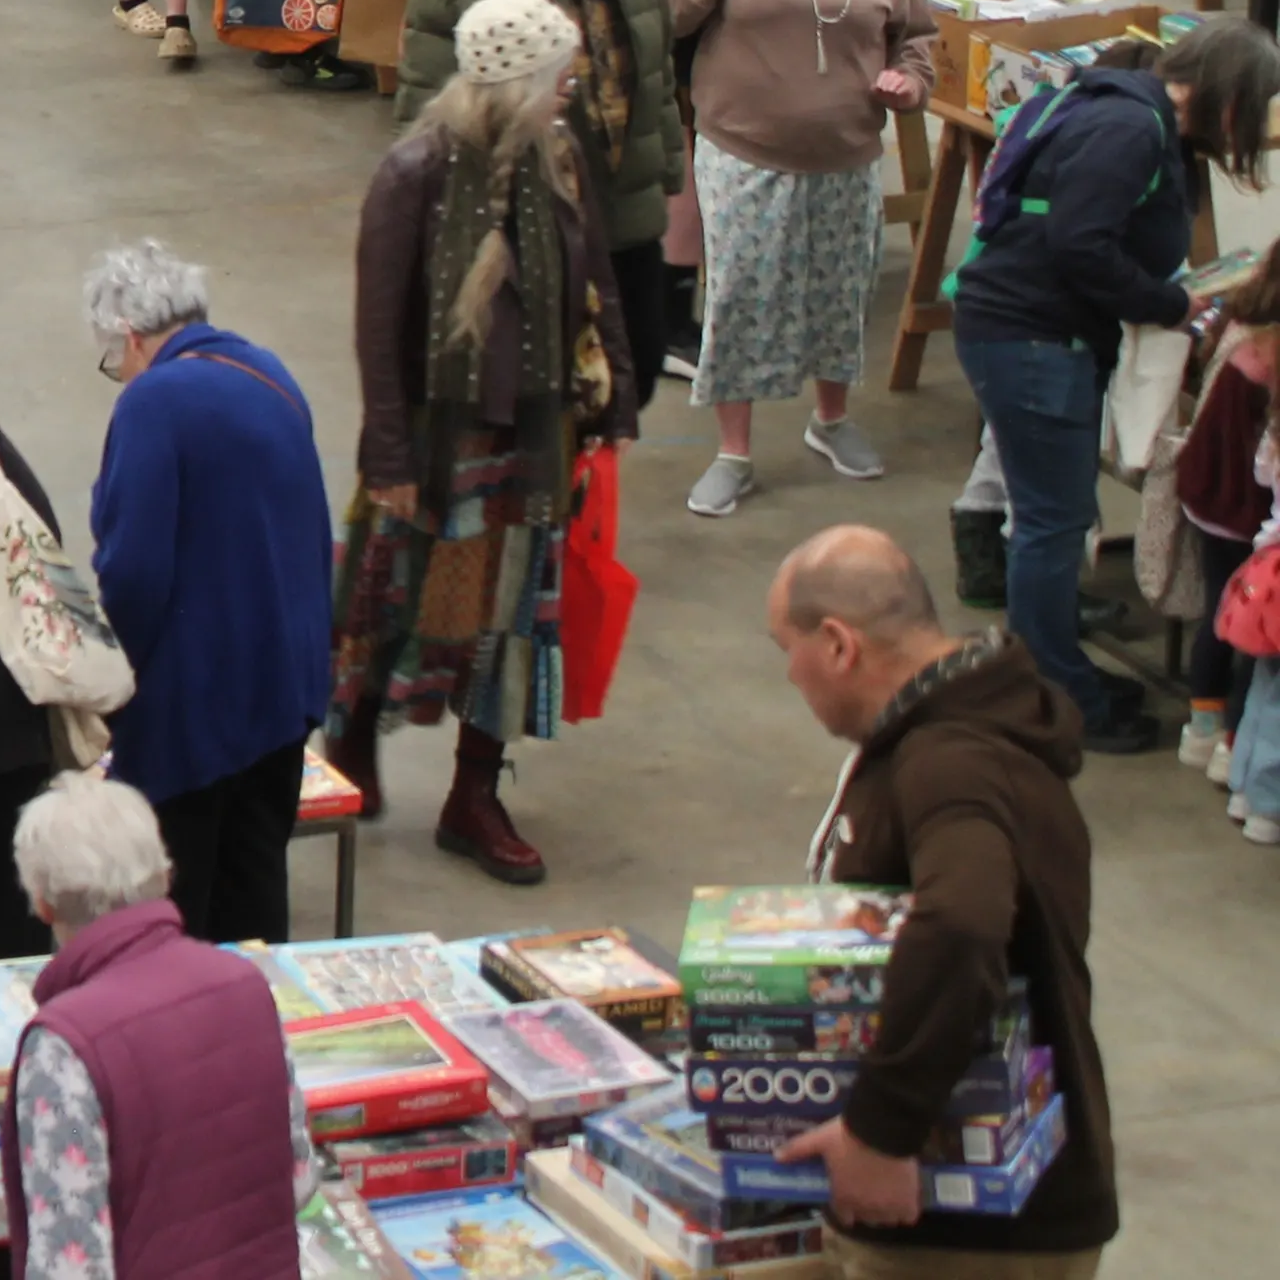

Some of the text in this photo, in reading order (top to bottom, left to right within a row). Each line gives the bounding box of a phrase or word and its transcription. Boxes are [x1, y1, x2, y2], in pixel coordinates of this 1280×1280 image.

[701, 967, 755, 986] Gallery
[707, 1034, 774, 1051] 1000
[720, 1067, 837, 1104] 2000
